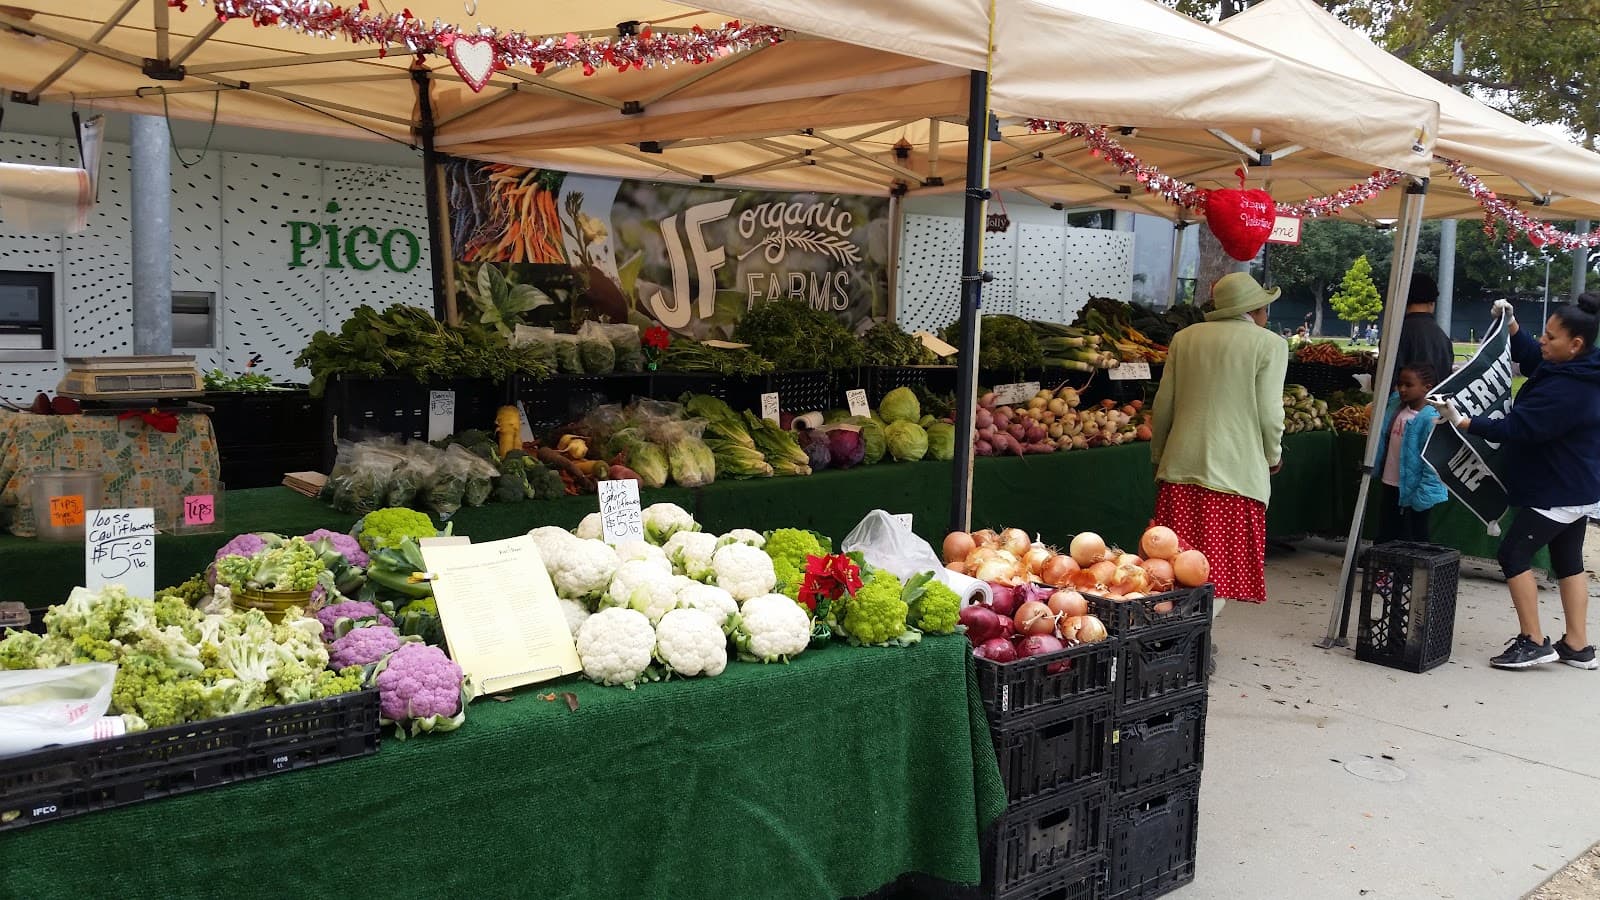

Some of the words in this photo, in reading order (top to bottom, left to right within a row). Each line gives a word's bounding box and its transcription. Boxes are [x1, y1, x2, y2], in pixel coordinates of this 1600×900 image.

[738, 198, 853, 264] organic
[650, 197, 737, 329] JF
[747, 270, 850, 311] FARMS
[33, 806, 57, 817] IFCO
